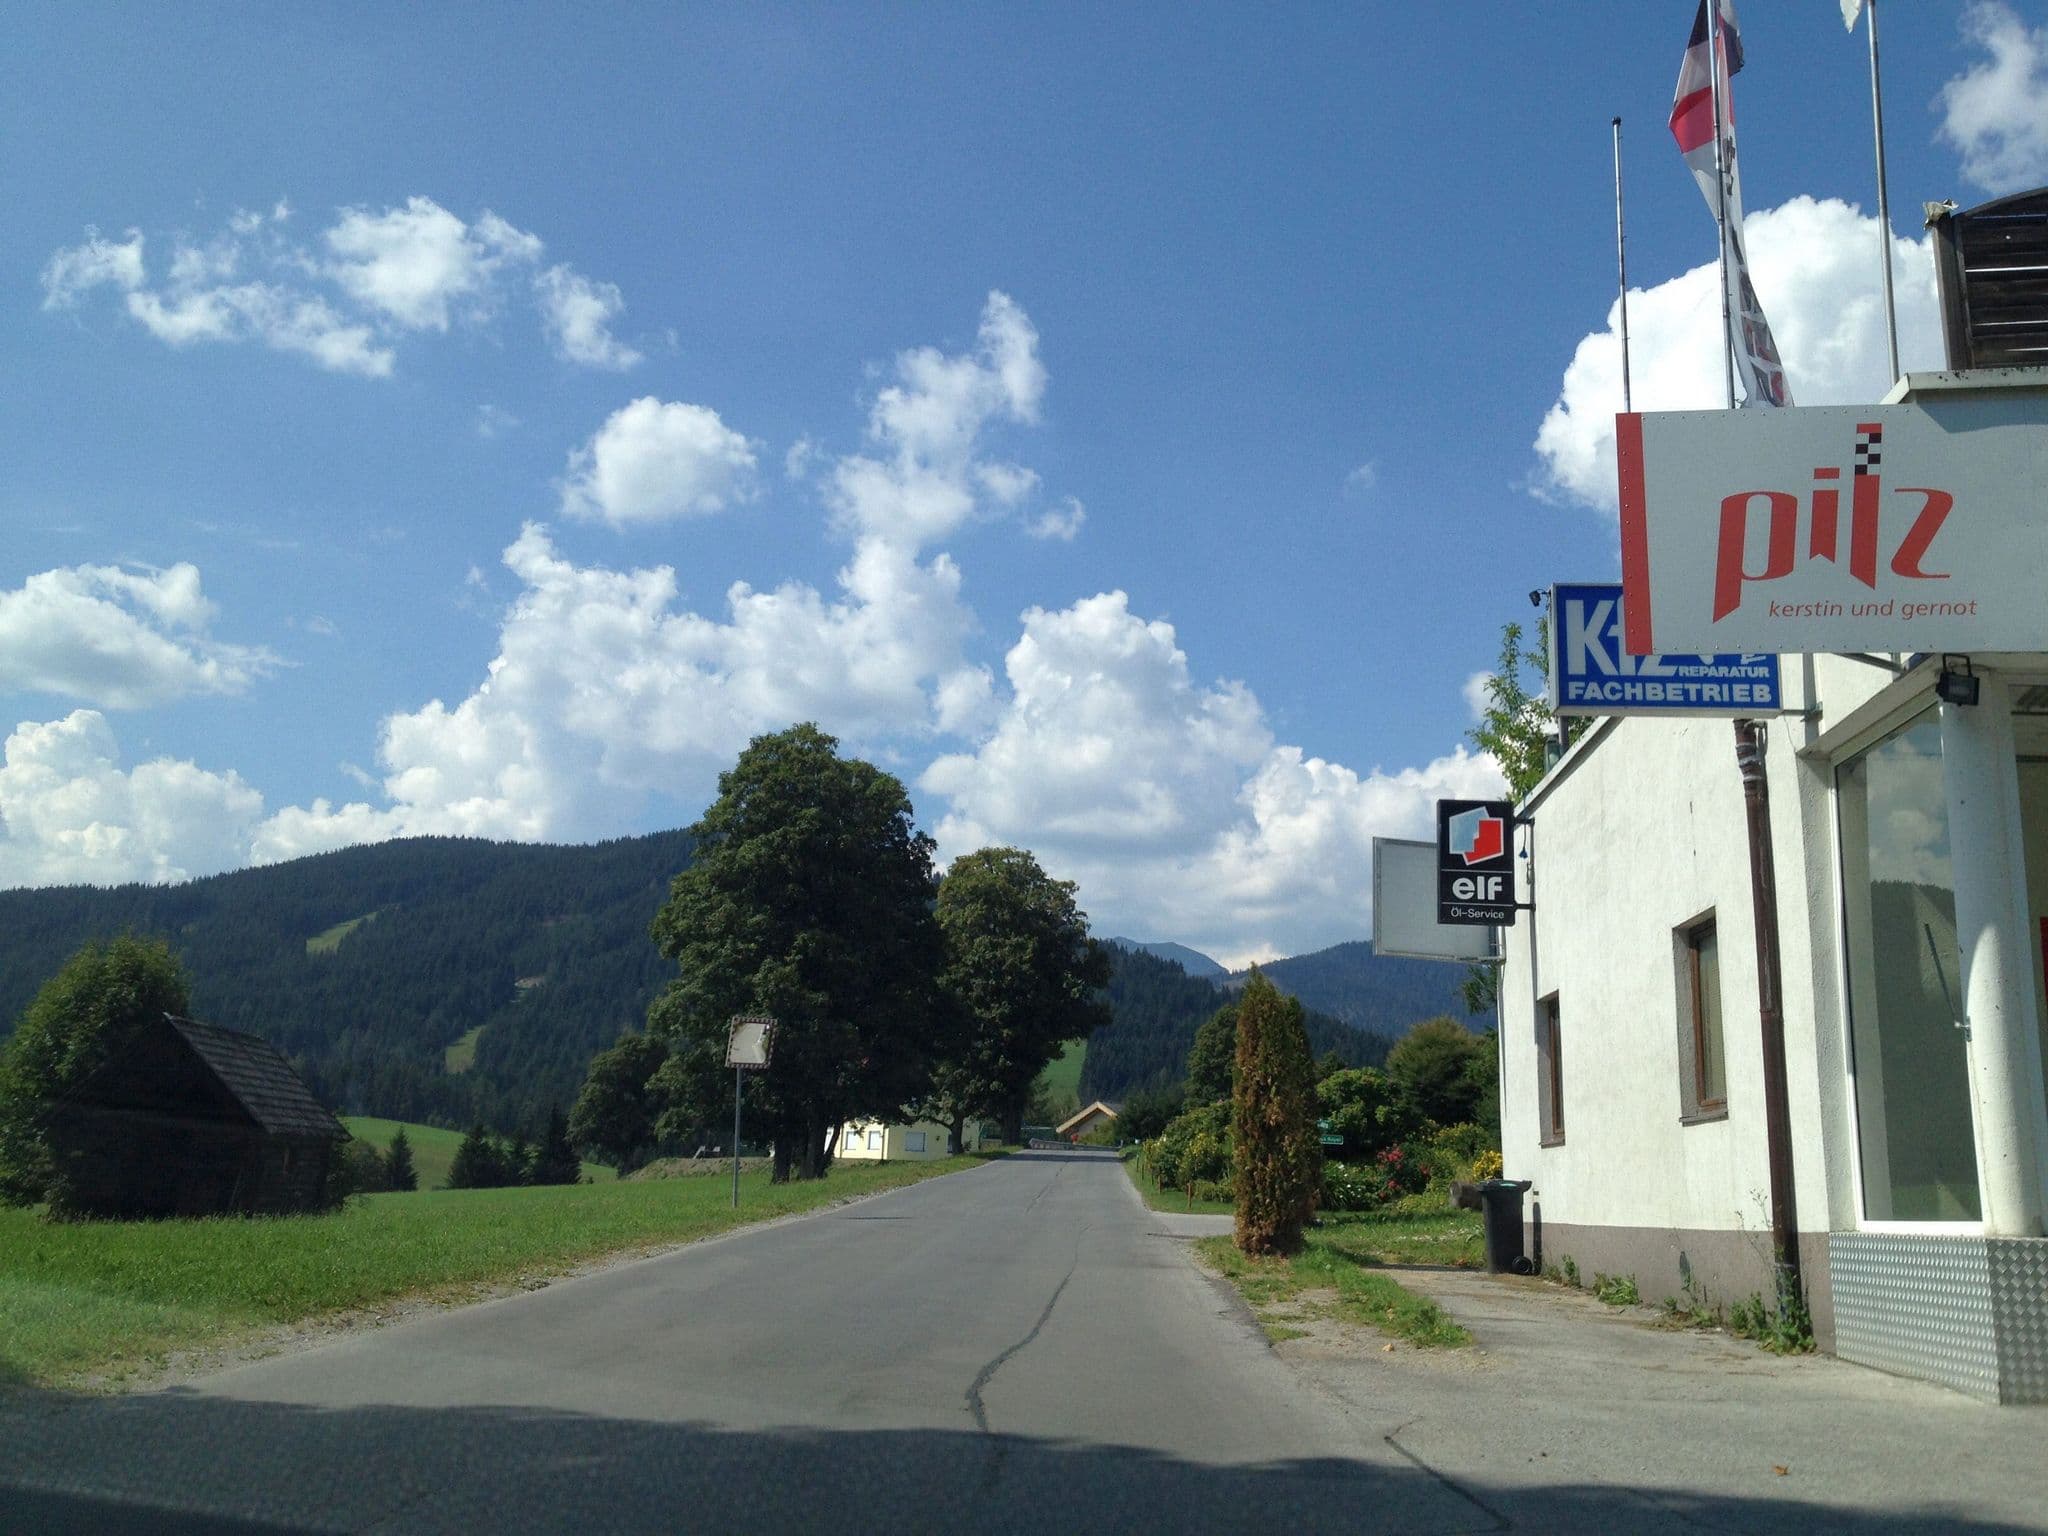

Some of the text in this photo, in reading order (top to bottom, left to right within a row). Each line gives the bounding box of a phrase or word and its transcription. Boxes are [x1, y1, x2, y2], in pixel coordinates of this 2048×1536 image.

[1713, 422, 1954, 624] pilz
[1769, 599, 1977, 621] kerstin und gernot
[1679, 665, 1770, 678] REPARATUR
[1568, 681, 1772, 703] FACHBETRIEB
[1452, 876, 1502, 900] elf
[1450, 906, 1504, 919] Öl-Service
